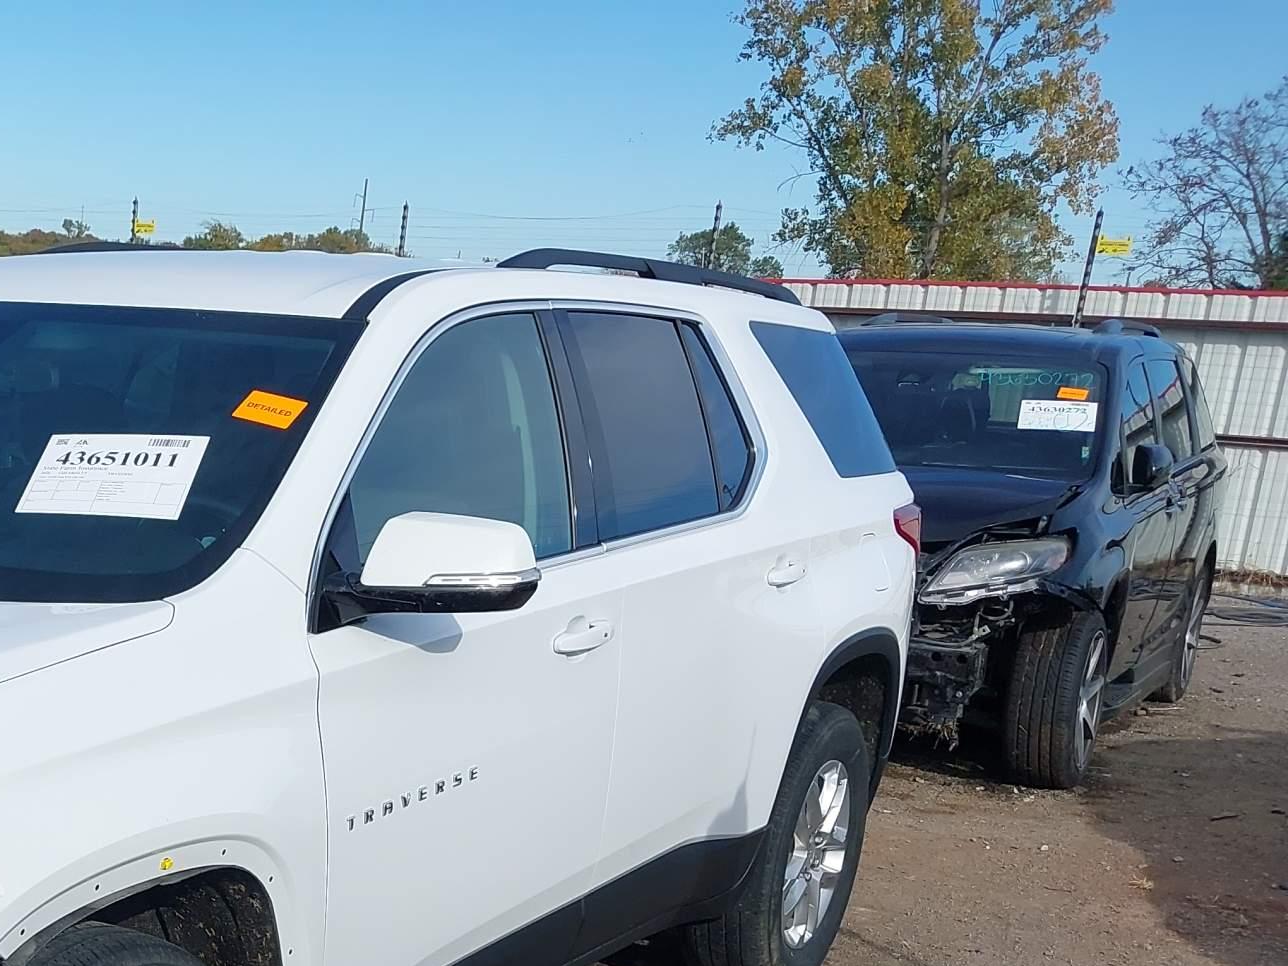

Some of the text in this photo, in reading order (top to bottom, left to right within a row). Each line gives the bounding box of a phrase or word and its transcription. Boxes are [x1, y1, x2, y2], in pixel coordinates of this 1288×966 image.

[246, 401, 292, 417] DETAILED
[55, 450, 179, 468] 43651011
[346, 766, 479, 832] TRAVERSE
